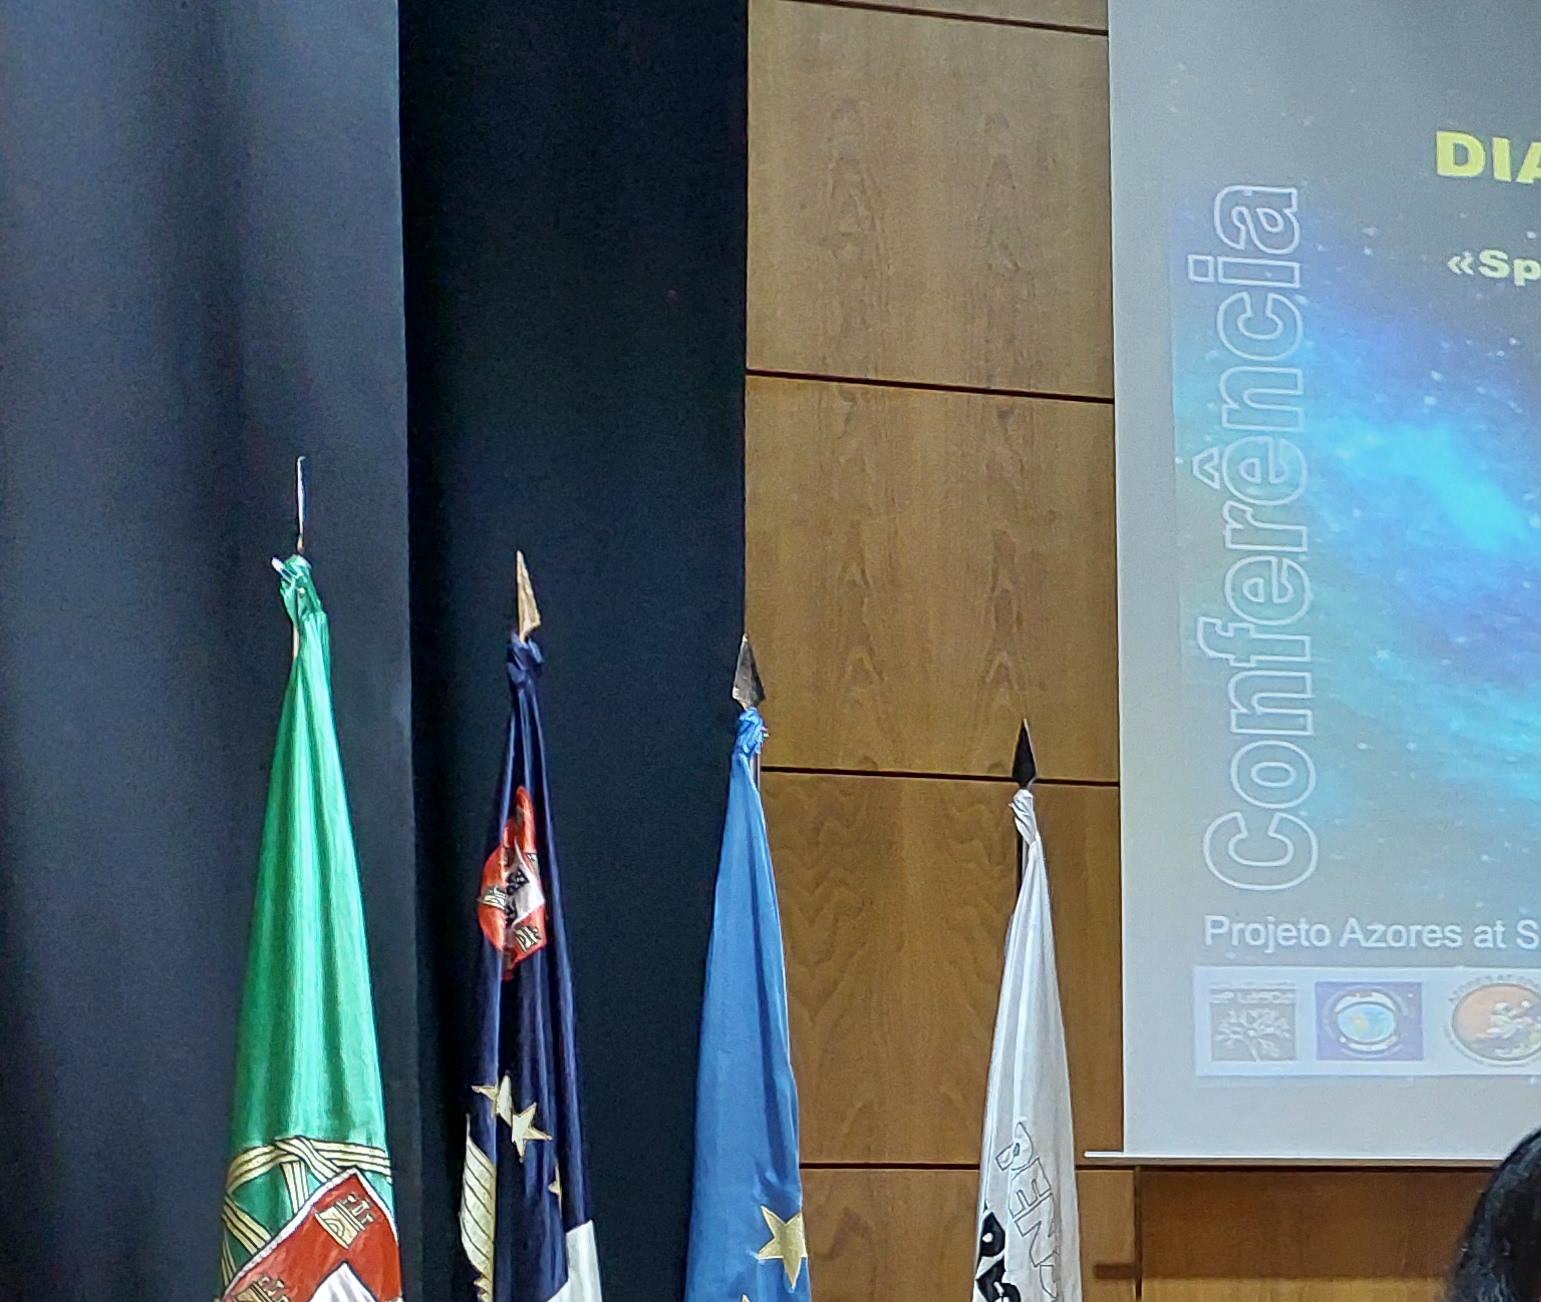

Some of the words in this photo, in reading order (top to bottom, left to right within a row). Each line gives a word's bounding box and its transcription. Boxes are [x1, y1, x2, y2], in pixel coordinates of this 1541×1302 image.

[1189, 185, 1319, 891] Conferência
[1204, 915, 1331, 952] Projeto
[1339, 918, 1464, 949] Azores
[1473, 920, 1505, 949] at
